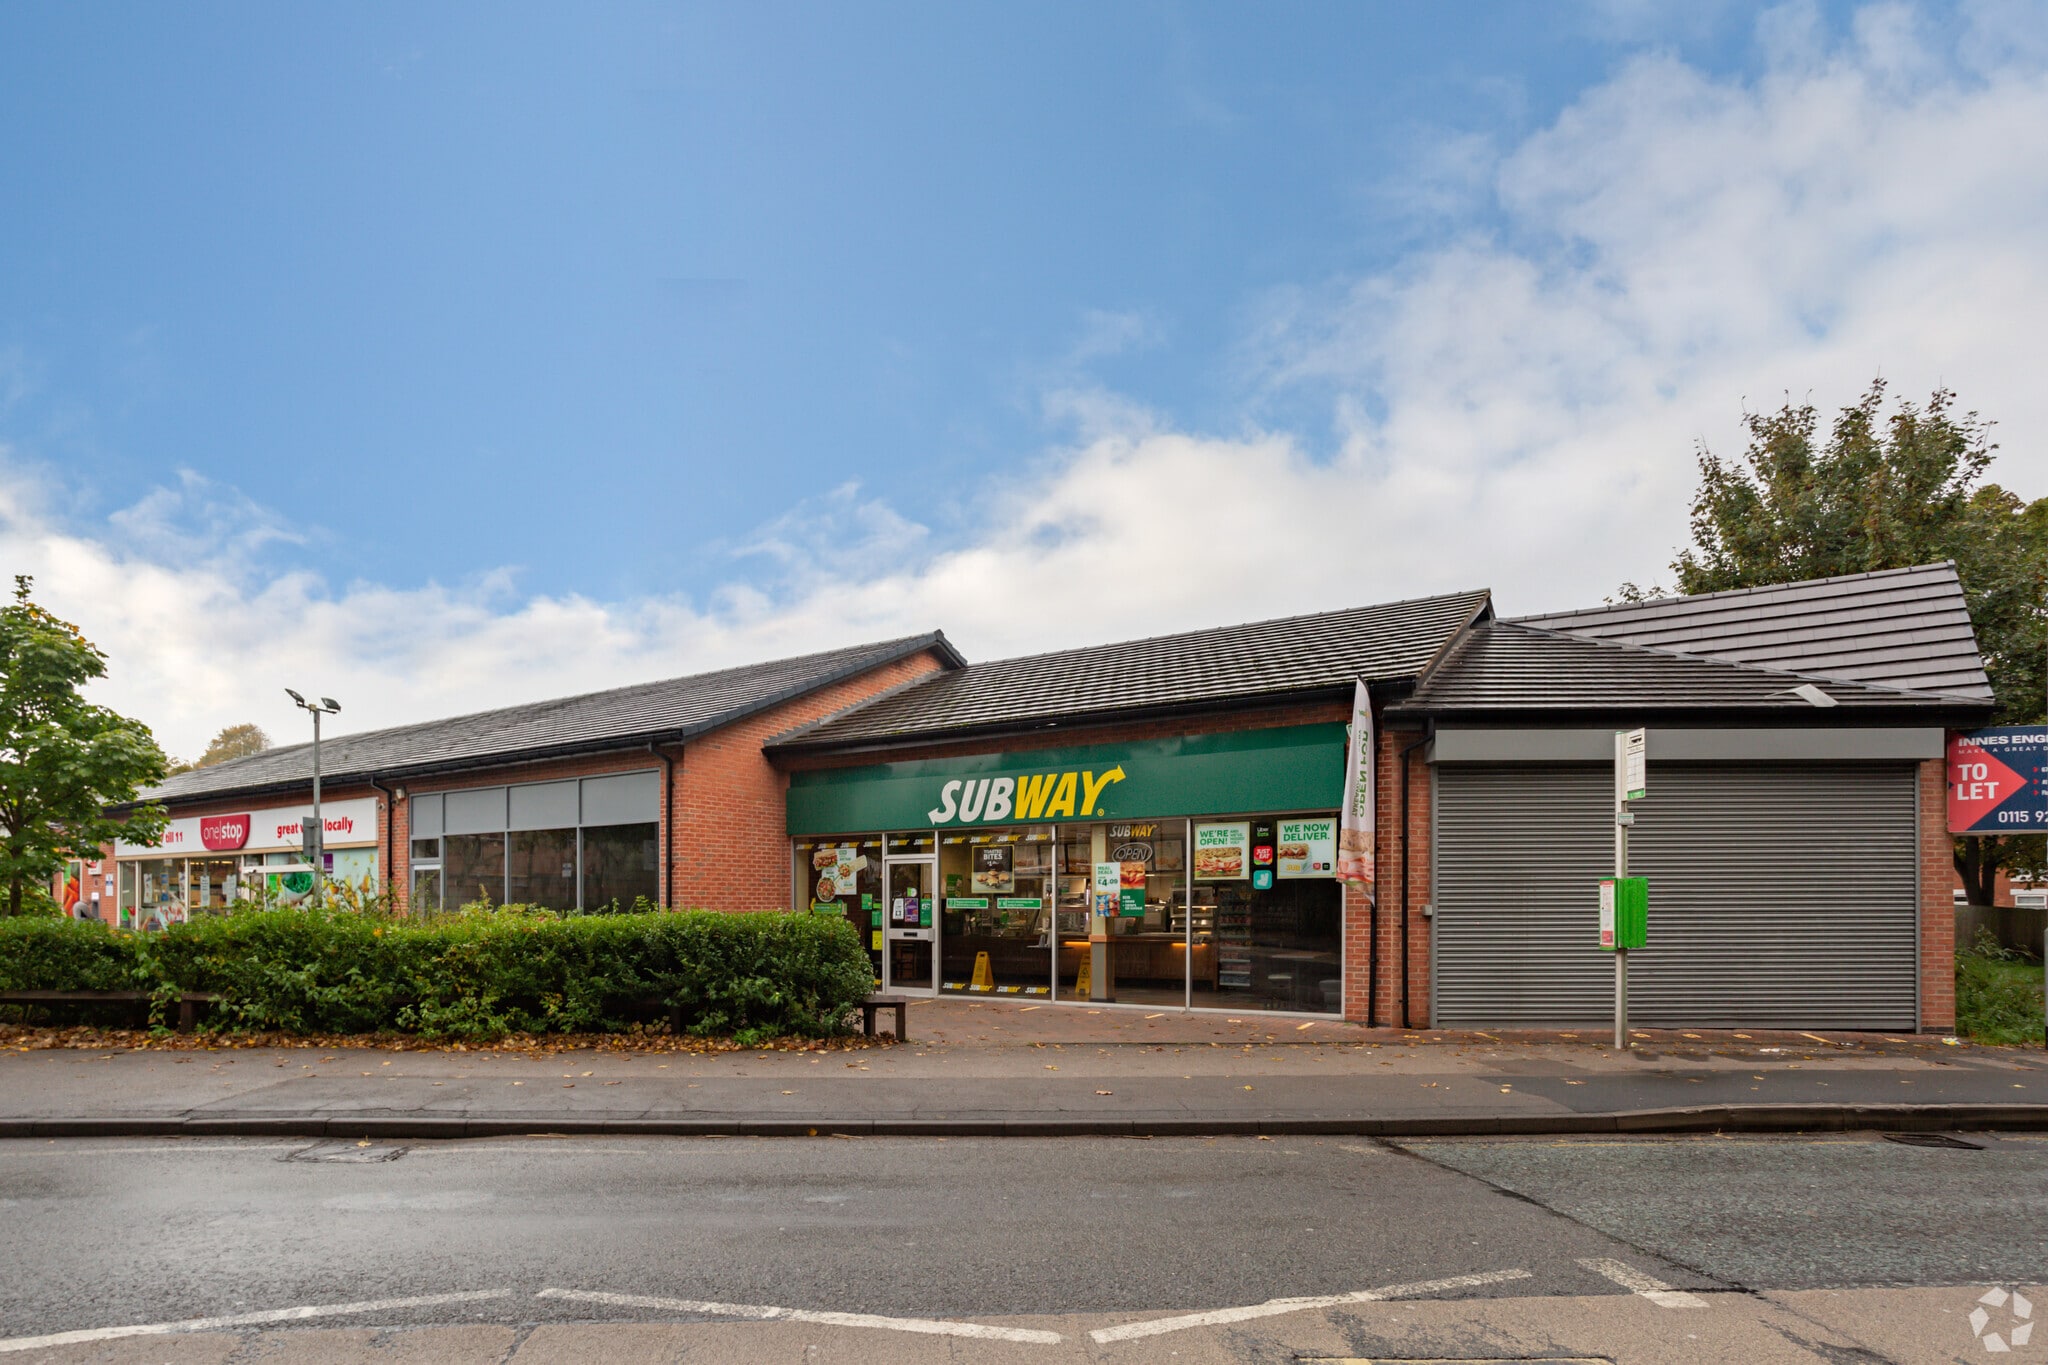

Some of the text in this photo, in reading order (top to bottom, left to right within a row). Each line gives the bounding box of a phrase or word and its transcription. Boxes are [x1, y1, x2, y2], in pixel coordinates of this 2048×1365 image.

[1958, 736, 2009, 746] INNES
[1957, 763, 1988, 781] TO
[928, 764, 1126, 826] SUBWAY
[1957, 781, 1999, 801] LET
[1998, 810, 2029, 823] 0115
[203, 822, 243, 844] one stop
[277, 822, 299, 838] great
[324, 816, 353, 834] locally
[1109, 823, 1158, 838] SUBWAY
[1199, 829, 1229, 838] WE'RE
[1283, 823, 1331, 833] WE NOW
[1199, 838, 1228, 846] OPEN!
[1283, 832, 1331, 842] DELIVER.
[1116, 848, 1148, 860] OPEN
